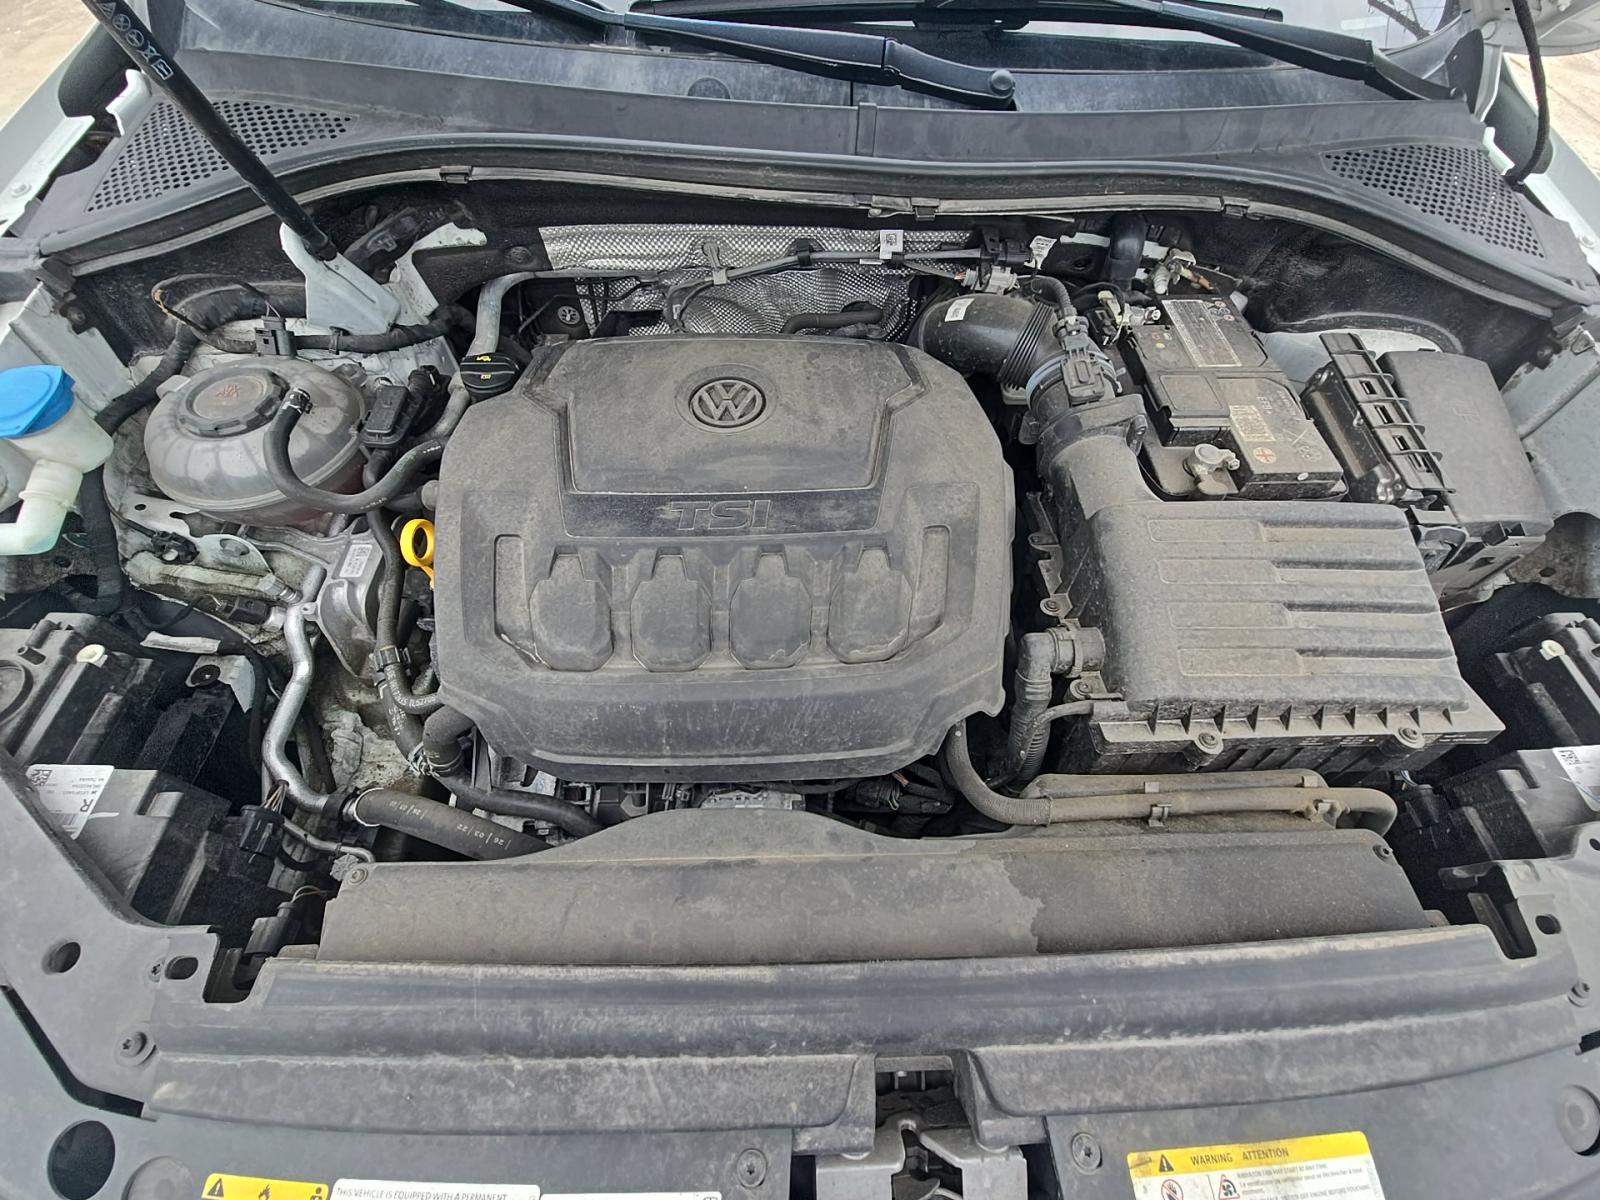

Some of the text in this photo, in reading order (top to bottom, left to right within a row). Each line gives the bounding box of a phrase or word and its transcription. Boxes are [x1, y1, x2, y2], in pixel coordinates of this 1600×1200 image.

[691, 379, 764, 425] VW
[671, 500, 771, 530] TSI
[80, 798, 94, 812] R
[1190, 1147, 1290, 1166] WARNING ATTENTION
[336, 1187, 508, 1200] THIS VEHICLE IS EQUIPPED WITH A PERMANENT
